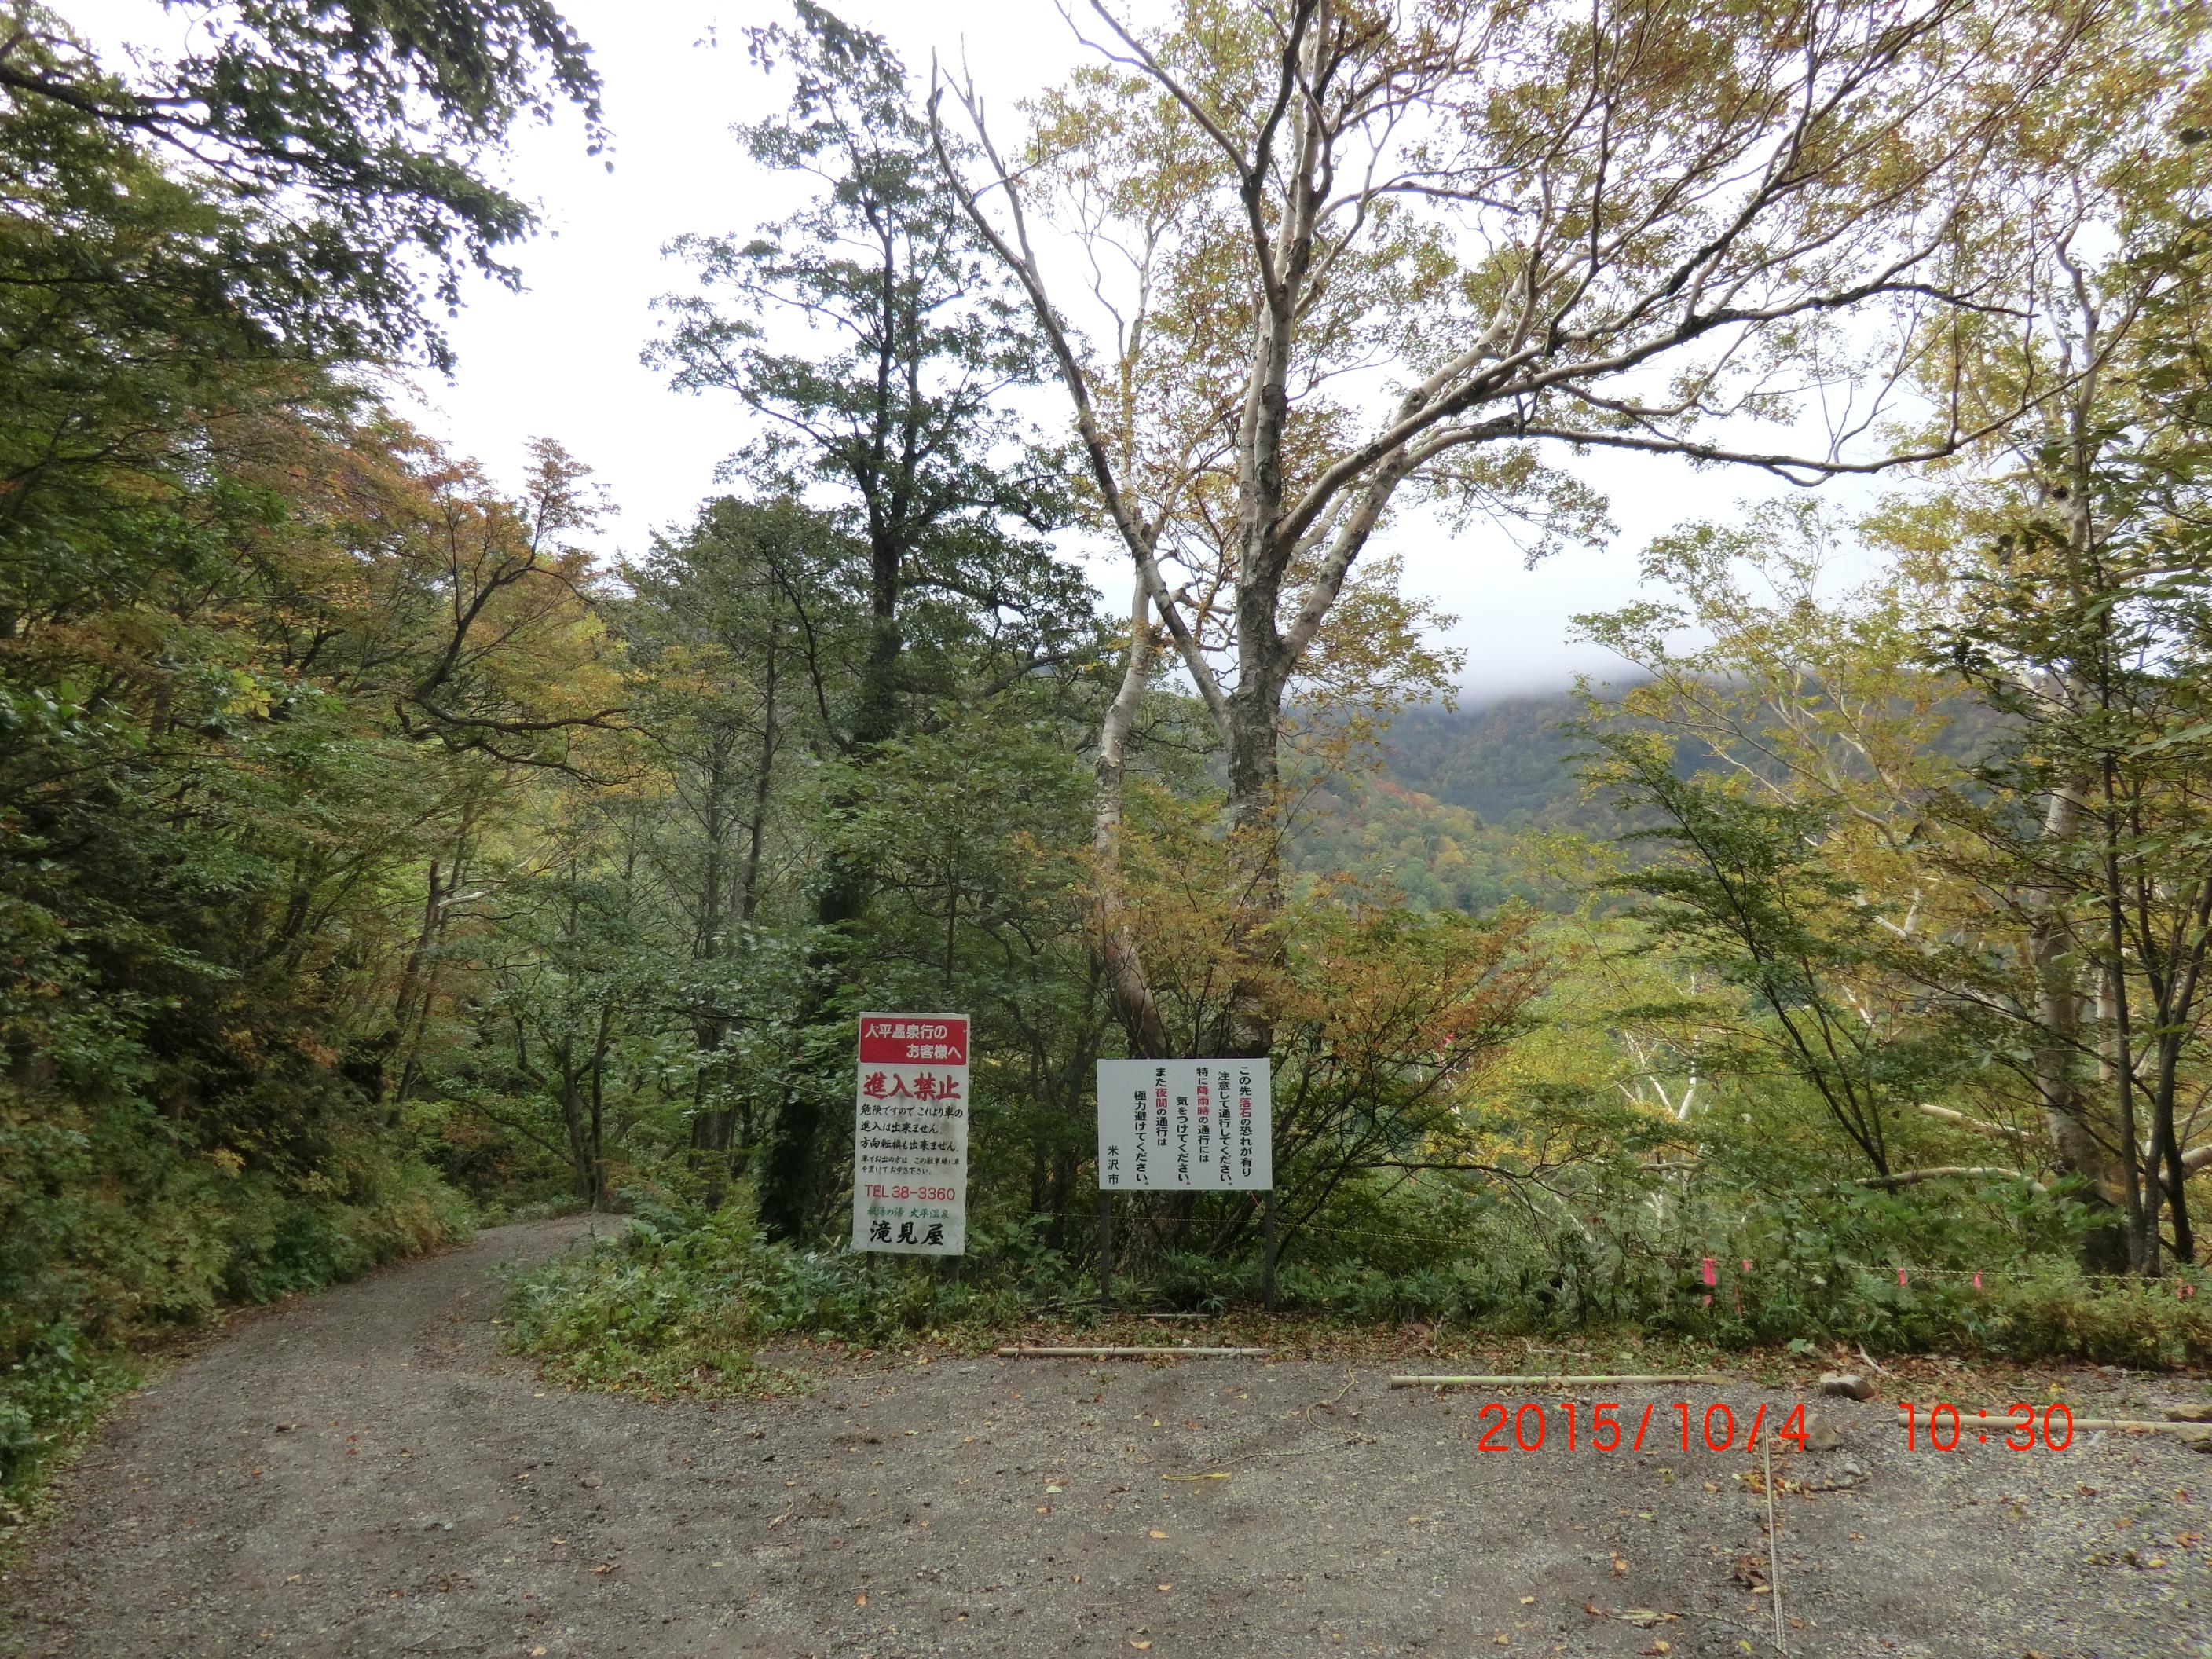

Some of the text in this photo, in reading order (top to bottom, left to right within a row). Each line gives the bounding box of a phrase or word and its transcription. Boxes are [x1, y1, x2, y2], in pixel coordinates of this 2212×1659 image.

[863, 1071, 961, 1101] 進入禁止
[906, 1044, 962, 1059] お客様へ
[1133, 1090, 1149, 1185] 極力避けてください。
[1155, 1067, 1168, 1146] また夜間の通行は
[1176, 1096, 1191, 1185] 気をつけてください。
[1196, 1067, 1210, 1163] 特に降雨時の通行には
[1218, 1071, 1232, 1186] 注意して通行してください。
[1239, 1066, 1252, 1177] この先落石の恐れが有り
[865, 1184, 955, 1201] TEL 38-3360
[1107, 1144, 1119, 1185] 米沢市
[870, 1219, 943, 1246] 滝見屋
